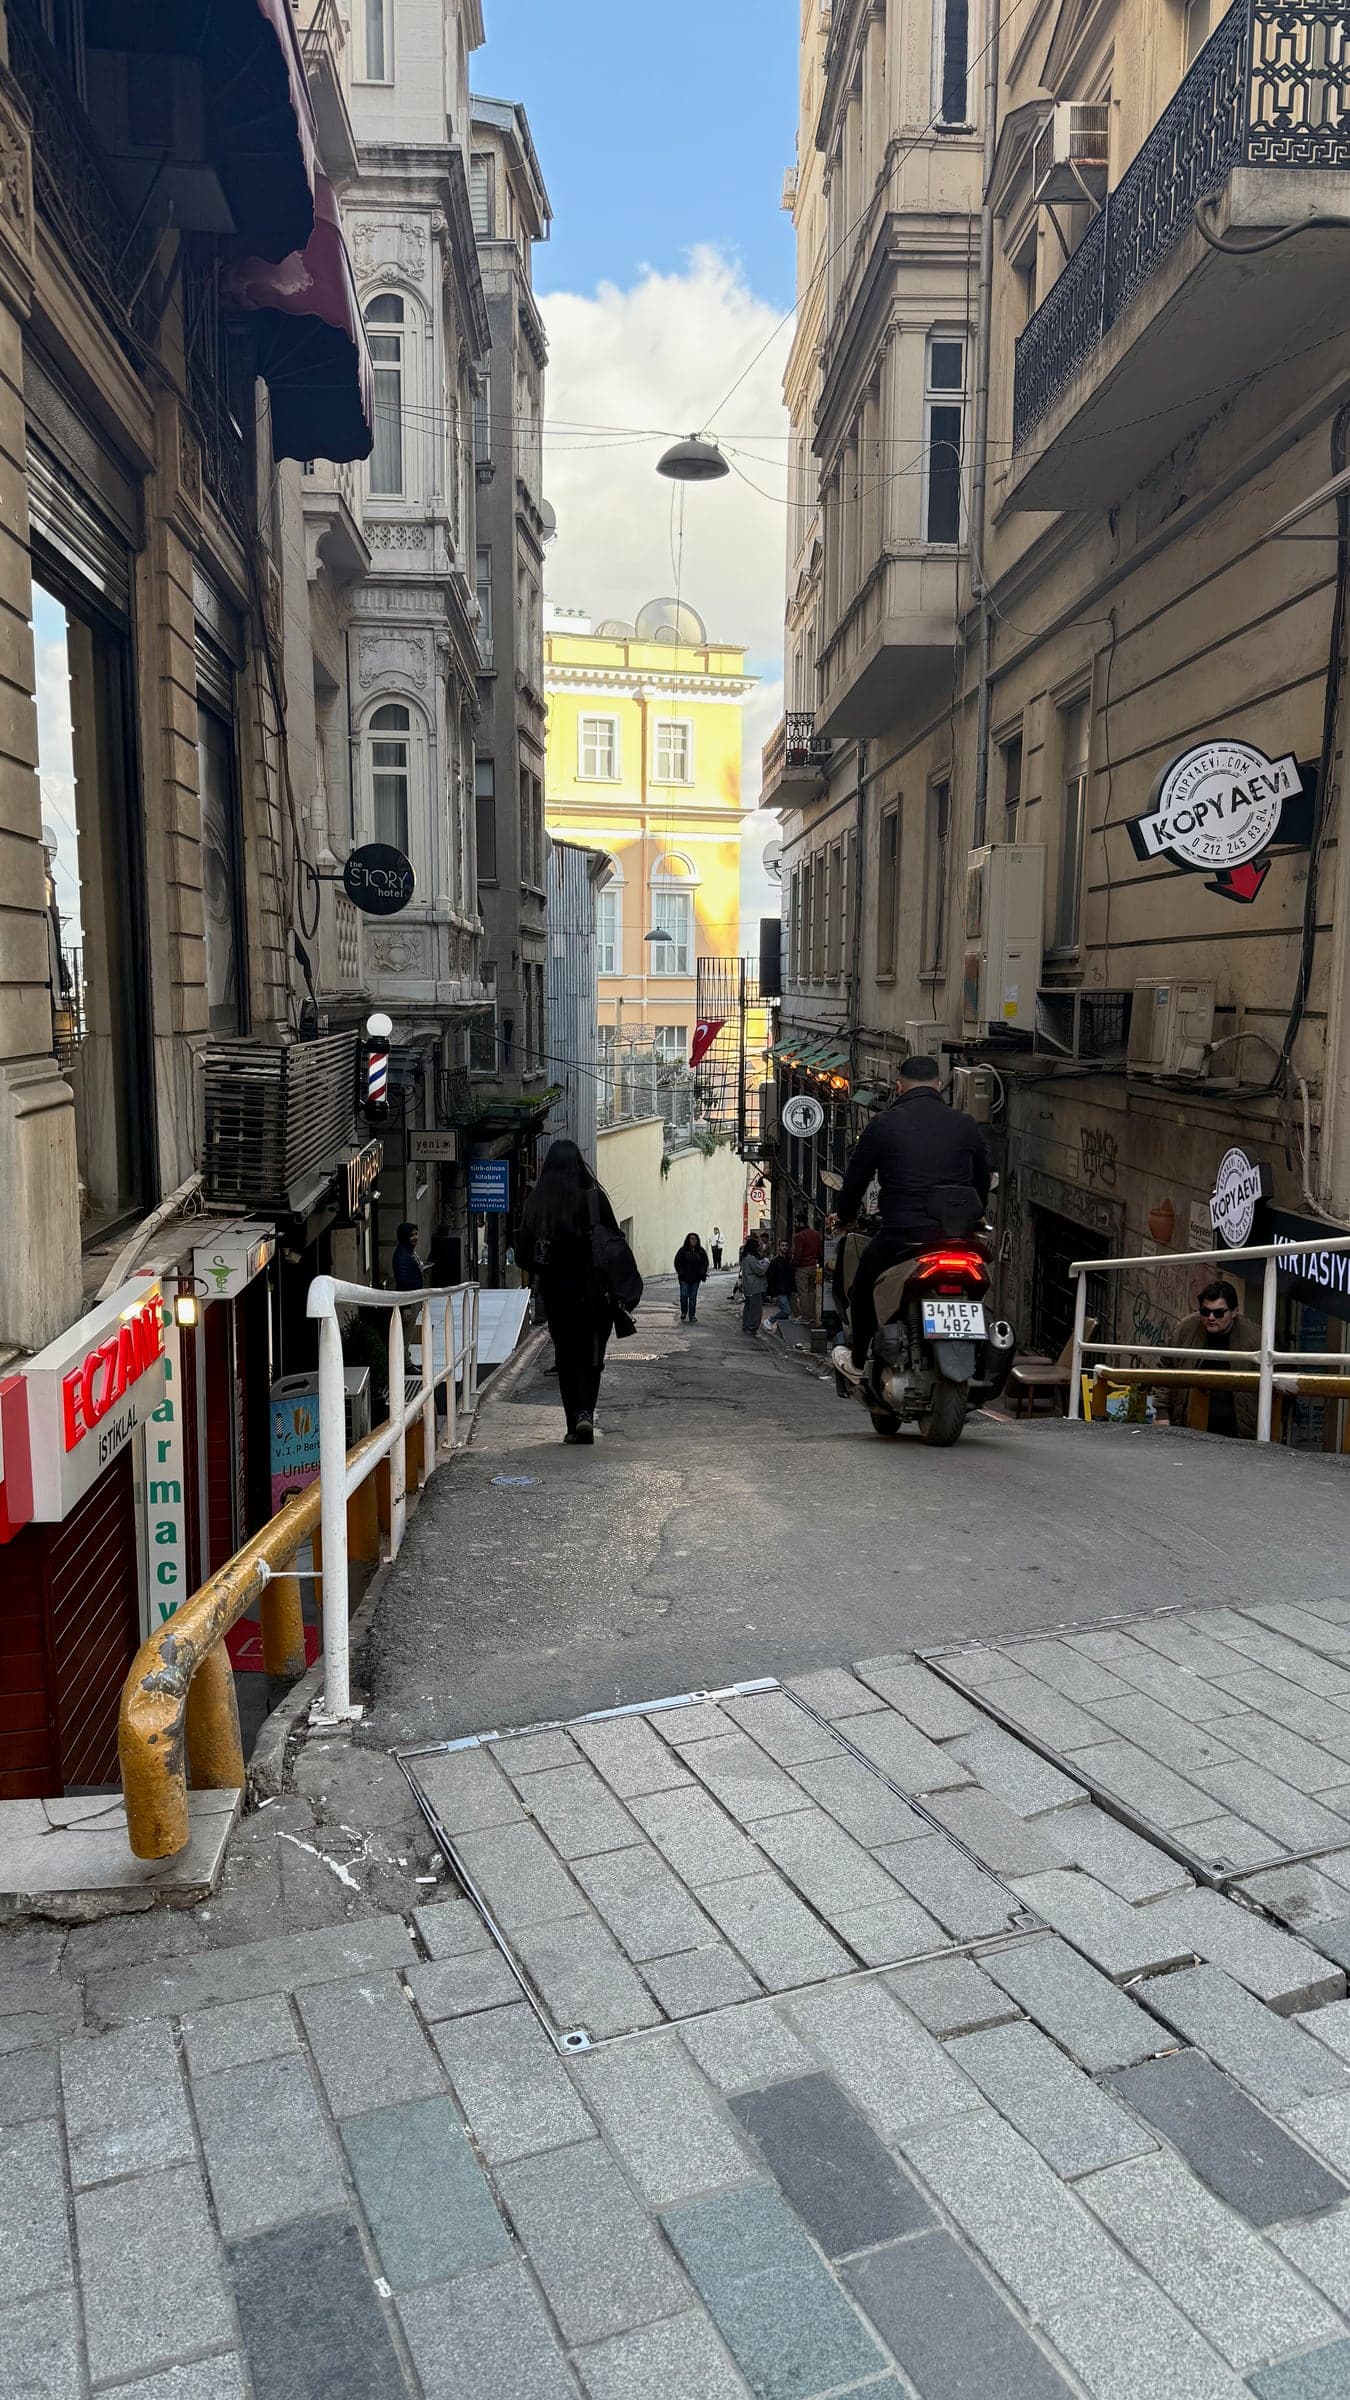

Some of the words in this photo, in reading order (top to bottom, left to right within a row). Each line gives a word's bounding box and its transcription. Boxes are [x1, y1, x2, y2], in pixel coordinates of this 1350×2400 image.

[1192, 837, 1200, 847] 0
[1203, 842, 1221, 856] 212
[1227, 838, 1247, 854] 245
[1247, 825, 1261, 839] 83
[350, 868, 409, 889] STORY
[378, 888, 404, 898] hotel
[753, 1191, 762, 1199] 20
[943, 1319, 972, 1332] 482
[62, 1293, 166, 1453] ECZANE
[283, 1459, 320, 1479] Unise
